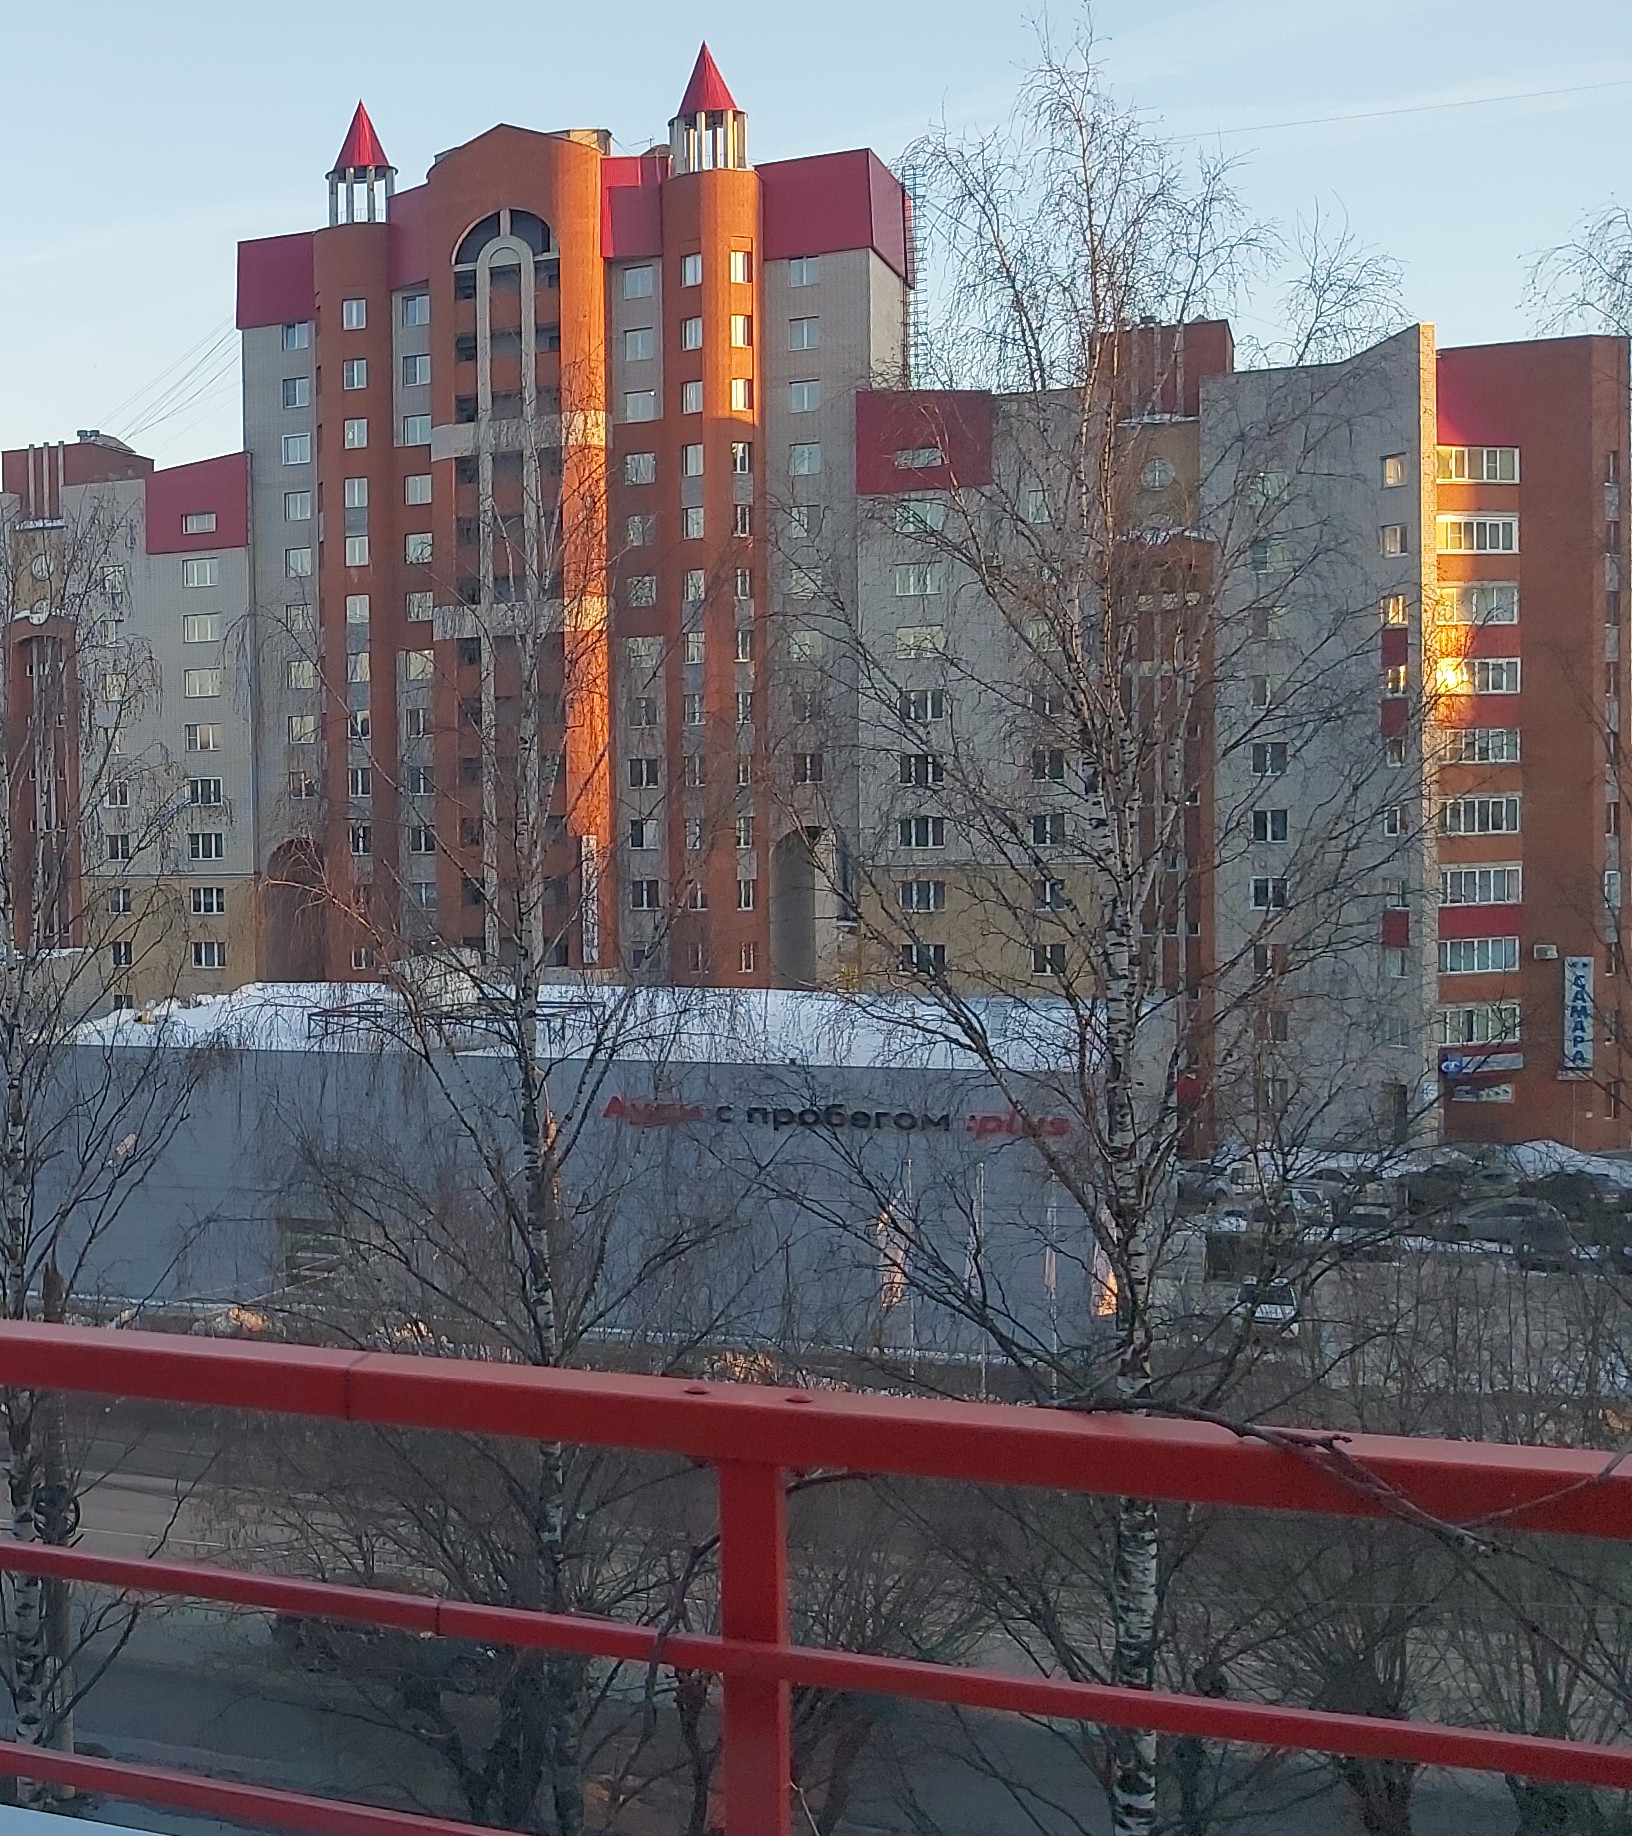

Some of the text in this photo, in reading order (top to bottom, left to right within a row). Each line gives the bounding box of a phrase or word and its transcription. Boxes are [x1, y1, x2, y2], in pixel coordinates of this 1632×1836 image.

[1570, 974, 1589, 1064] САМАРА
[602, 1095, 704, 1128] Ау
[715, 1105, 735, 1123] с
[746, 1103, 950, 1132] пробегом
